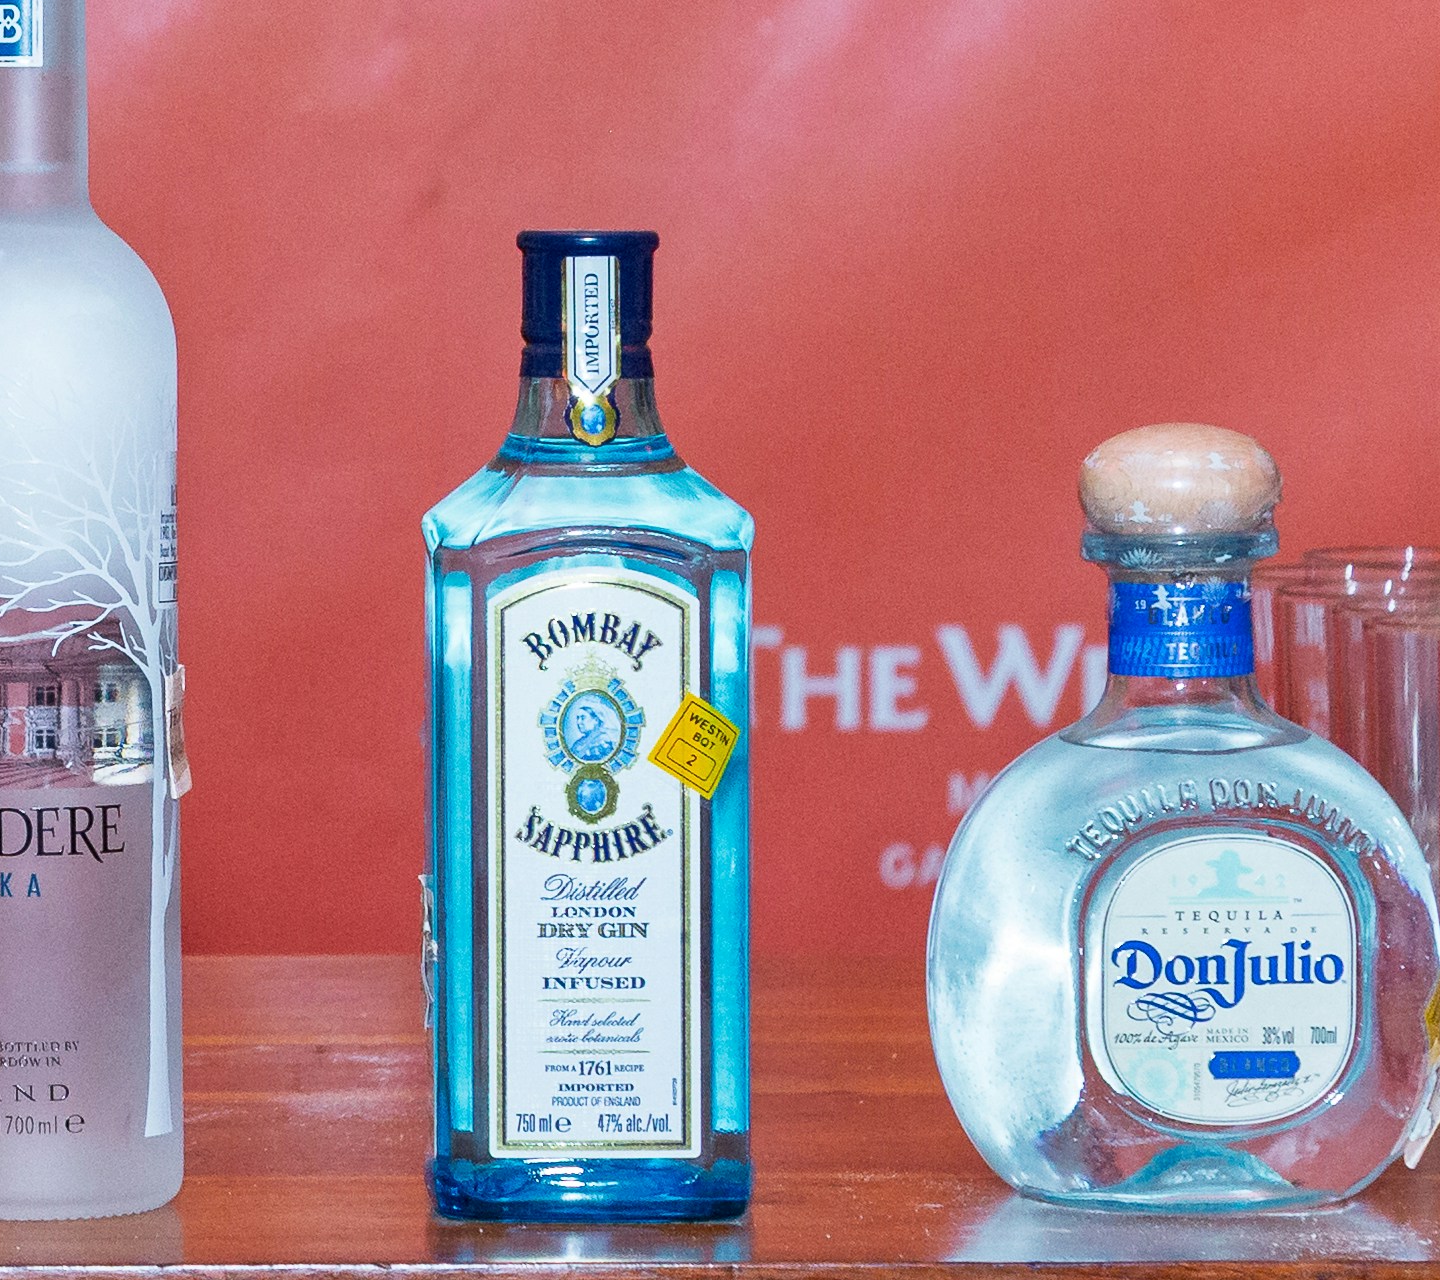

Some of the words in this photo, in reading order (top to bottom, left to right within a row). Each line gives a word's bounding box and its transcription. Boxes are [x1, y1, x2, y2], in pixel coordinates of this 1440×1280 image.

[584, 273, 600, 376] IMPORTED
[521, 612, 664, 671] BOMBAY
[689, 712, 731, 746] WESTIN
[692, 732, 716, 751] BQT
[686, 754, 697, 767] 2
[1065, 777, 1197, 861] TEQUILA
[1208, 777, 1279, 810] DON
[515, 802, 668, 864] SAPPHIRE
[540, 873, 647, 901] Distilled
[551, 906, 637, 918] LONDON
[1175, 910, 1283, 923] TEQUILA
[537, 922, 593, 938] DRY
[597, 922, 650, 938] GIN
[1141, 927, 1271, 935] RESERVA
[1290, 926, 1317, 934] DE
[556, 947, 632, 974] Vapour
[542, 976, 646, 990] INFUSED
[549, 1009, 592, 1027] Hand
[593, 1011, 641, 1027] selected
[581, 1027, 645, 1043] botanicals
[1114, 1033, 1142, 1045] 100%
[1143, 1032, 1158, 1044] de
[1206, 1035, 1249, 1044] MEXICO
[1310, 1026, 1337, 1045] 700ml
[65, 1040, 79, 1052] BY
[46, 1056, 61, 1067] IN
[545, 1064, 570, 1072] FROM
[579, 1060, 612, 1076] 1761
[614, 1064, 645, 1073] RECIPE
[558, 1083, 634, 1092] IMPORTED
[552, 1096, 588, 1107] PRODUCT
[591, 1096, 602, 1107] OF
[604, 1096, 641, 1107] ENGLAND
[5, 1115, 34, 1135] 700
[39, 1116, 57, 1134] ml
[516, 1113, 536, 1133] 750
[539, 1113, 552, 1133] ml
[598, 1113, 622, 1133] 47%
[626, 1113, 672, 1133] alc./vol.
